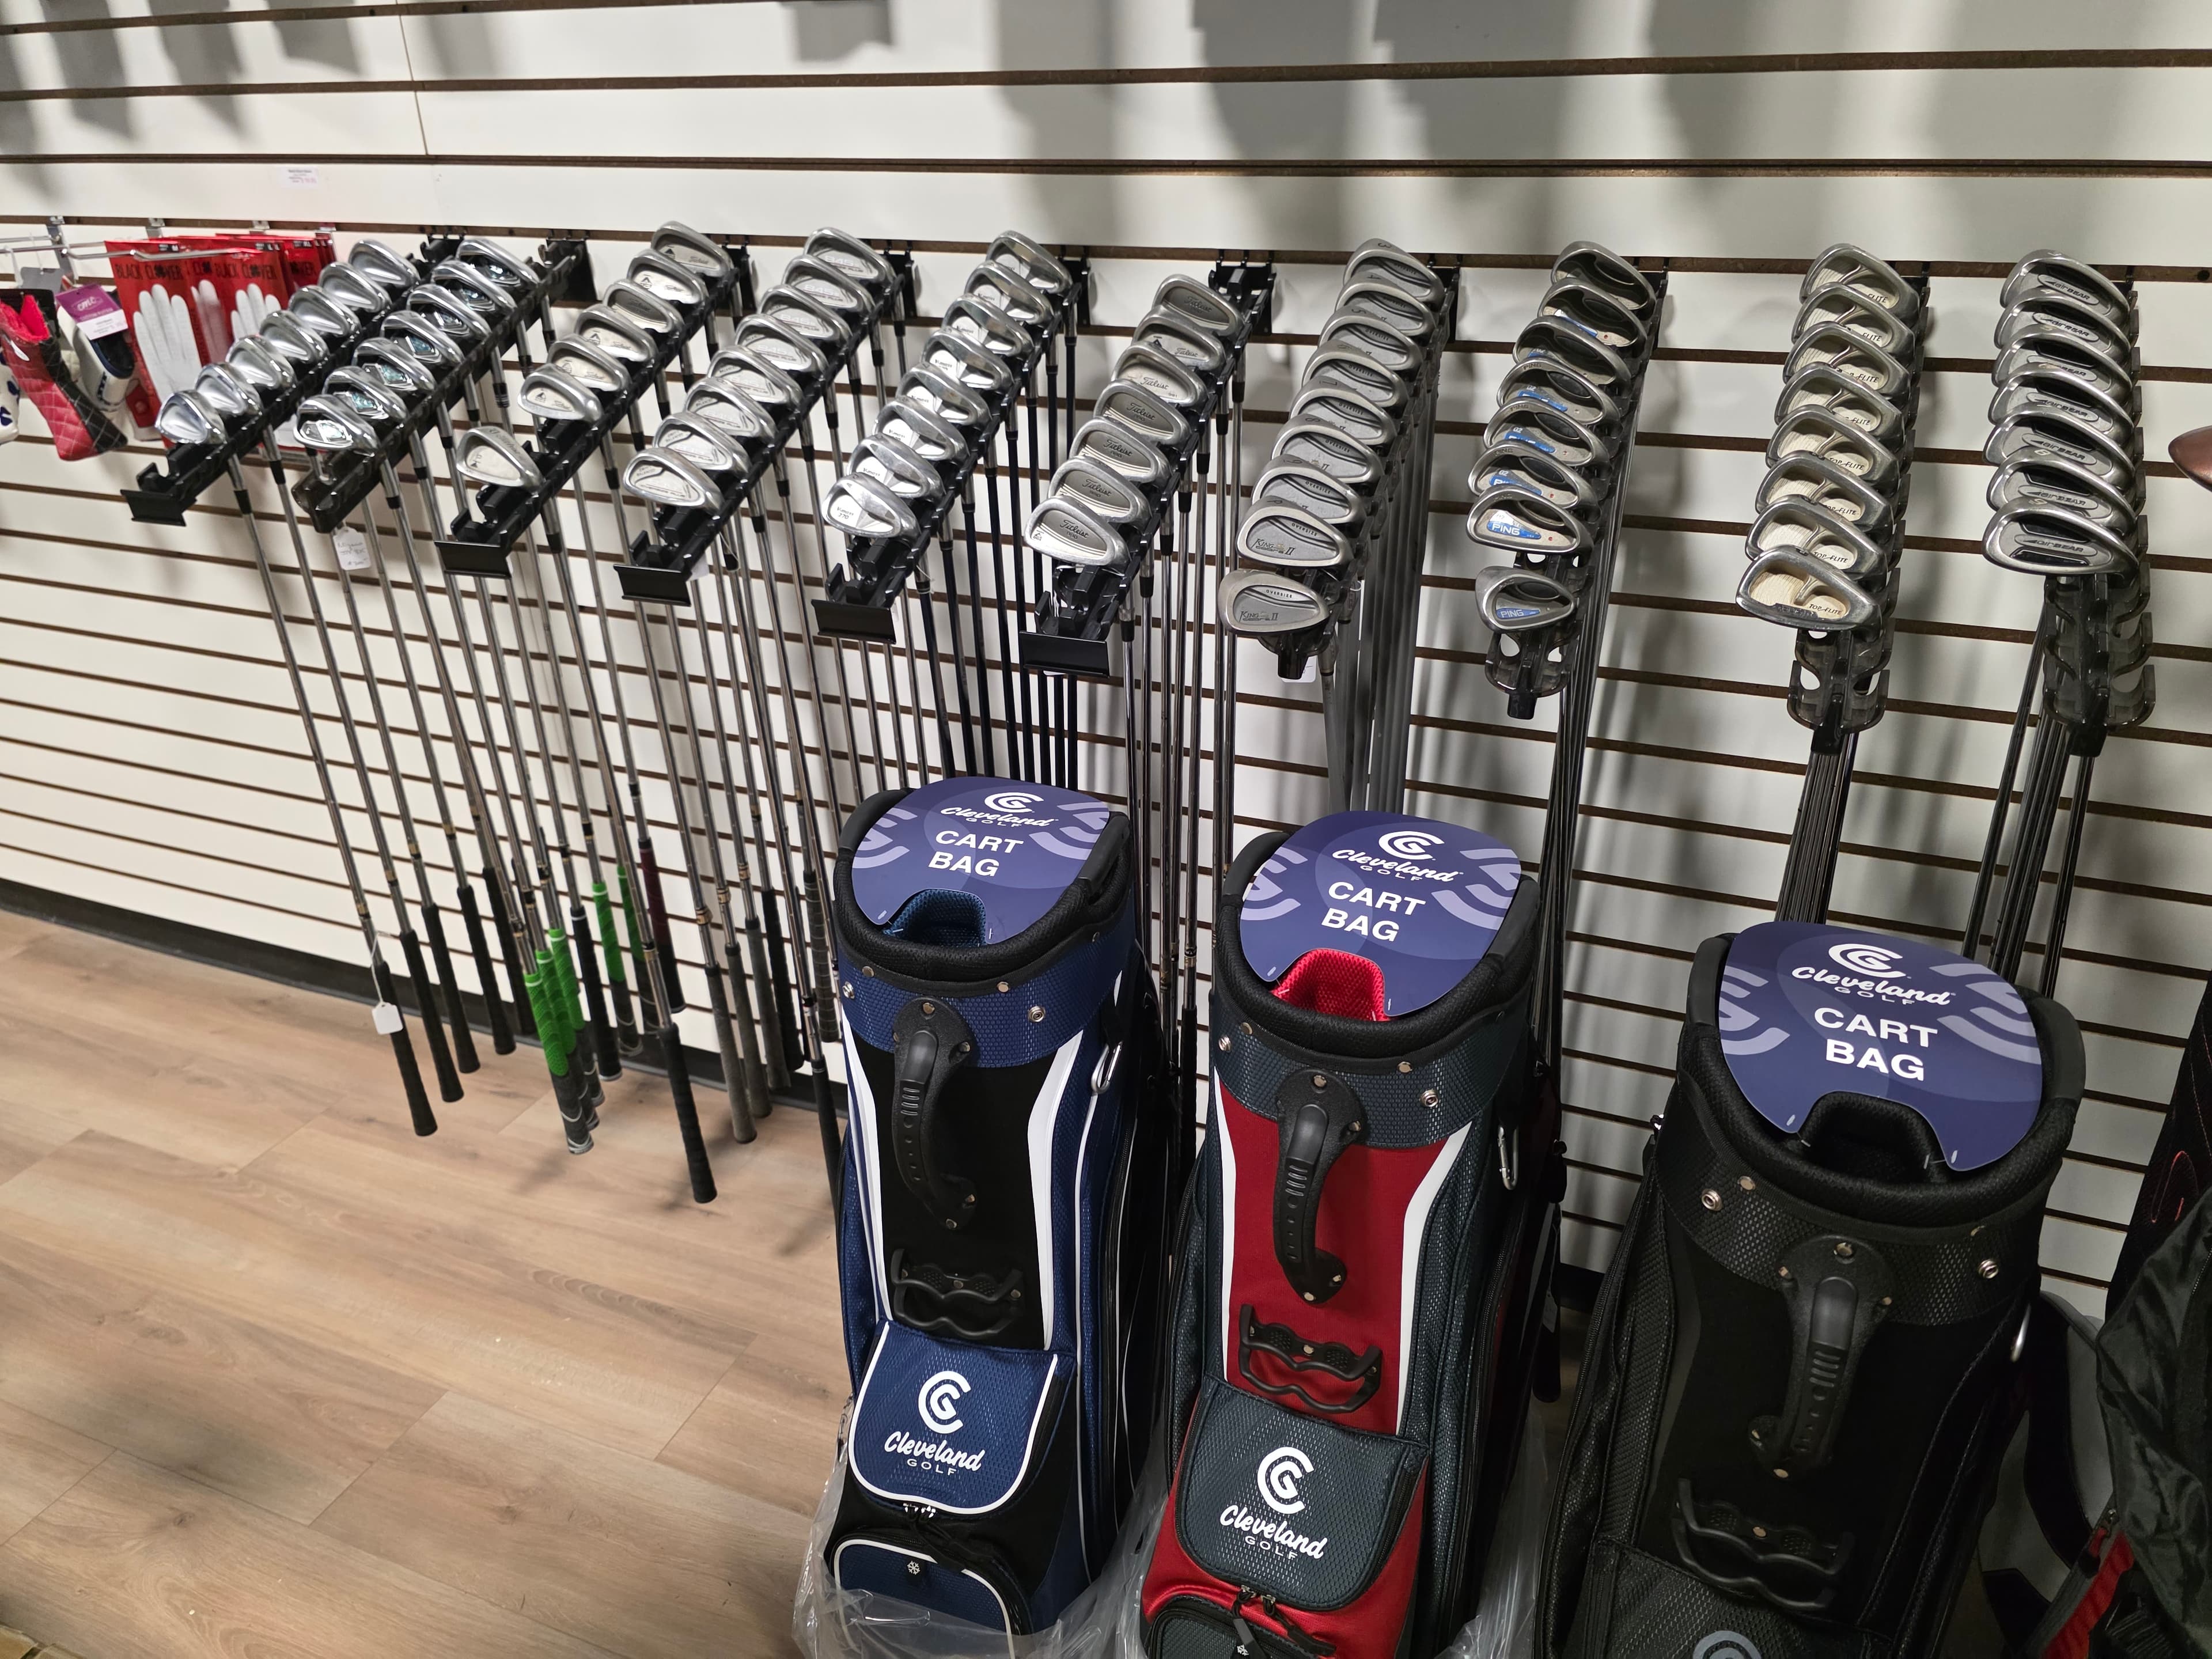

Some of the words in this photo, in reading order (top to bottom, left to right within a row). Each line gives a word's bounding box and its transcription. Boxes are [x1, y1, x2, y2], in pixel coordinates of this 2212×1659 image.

[1365, 328, 1389, 341] OVERSIZE
[1349, 364, 1373, 377] OVERSIZE
[1141, 377, 1169, 390] Titleist
[1127, 403, 1156, 420] Titleist
[1339, 403, 1364, 415] OVERSIZE
[1103, 440, 1132, 457] Titleist
[1325, 440, 1350, 453] OVERSIZE
[1082, 479, 1112, 496] Titleist
[1305, 481, 1331, 494] OVERSIZE
[1060, 520, 1089, 538] Titleist
[1291, 522, 1318, 536] OVERSIZE
[1492, 523, 1520, 536] PING
[1285, 547, 1296, 555] II
[1266, 589, 1292, 599] OVERSIZE
[1271, 612, 1279, 621] II
[1500, 609, 1524, 618] PING
[940, 806, 1056, 827] Cleveland
[965, 817, 1024, 827] GOLF
[935, 830, 1024, 853] CART
[927, 851, 999, 877] BAG
[1332, 849, 1461, 882] Cleveland
[1360, 865, 1423, 881] GOLF
[1328, 881, 1426, 916] CART
[1321, 907, 1400, 942] BAG
[1791, 967, 1952, 1006] Cleveland
[1834, 986, 1915, 1005] GOLF
[1814, 1007, 1938, 1048] CART
[1825, 1038, 1925, 1081] BAG
[884, 1431, 986, 1472] Cleveland
[906, 1458, 958, 1476] GOLF
[1219, 1505, 1328, 1559] Cleveland
[1244, 1535, 1298, 1560] GOLF
